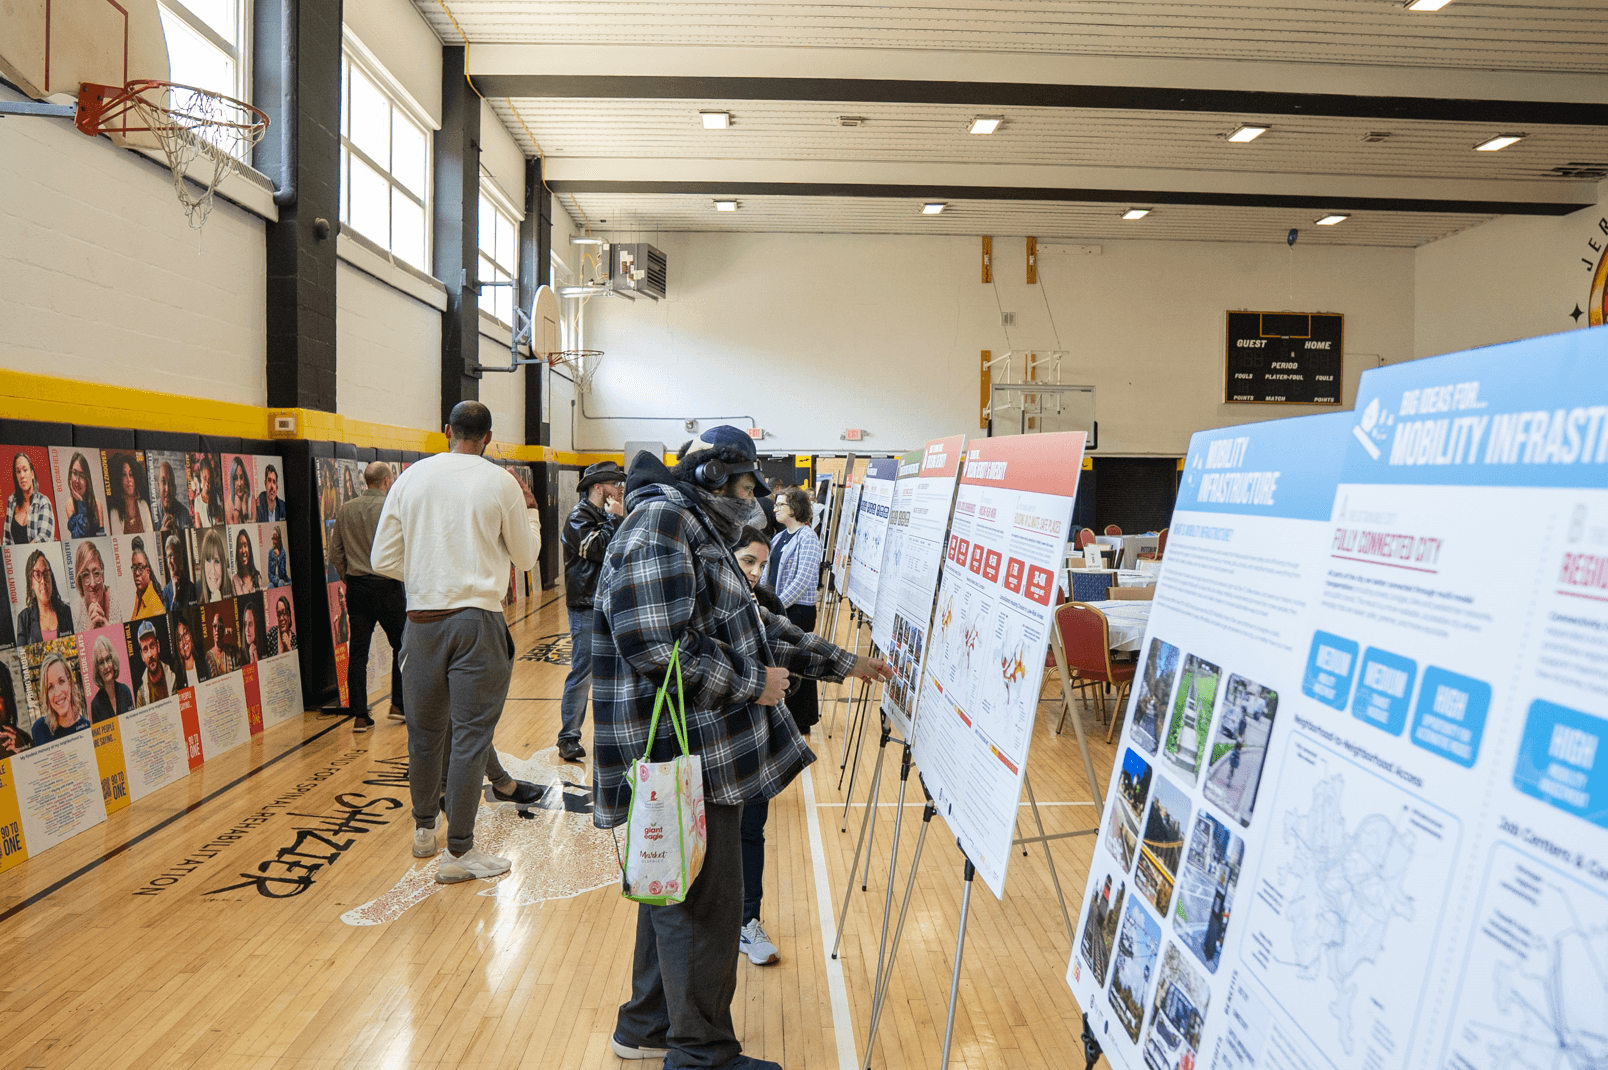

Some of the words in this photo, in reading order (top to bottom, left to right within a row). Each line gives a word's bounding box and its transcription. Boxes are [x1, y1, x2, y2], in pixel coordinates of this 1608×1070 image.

[1236, 339, 1267, 348] GUEST
[1304, 341, 1332, 350] HOME
[1400, 389, 1420, 416] BIG
[1420, 384, 1455, 414] IDEAS
[1205, 436, 1250, 468] MOBILITY
[1389, 416, 1490, 465] MOBILITY
[52, 448, 62, 492] BLOOMFIELD
[101, 450, 112, 496] BELTZHOOVER
[1197, 471, 1281, 505] INFRASTRUCTURE
[64, 542, 73, 564] SOUTH
[113, 538, 122, 577] GREENFIELD
[1332, 528, 1357, 553] FULLY
[1358, 531, 1415, 560] CONNECTED
[1415, 536, 1445, 564] CITY
[4, 548, 14, 576] OLIVER
[66, 567, 75, 589] PERRY
[8, 577, 18, 604] MOUNT
[20, 648, 30, 678] GARDEN
[80, 658, 88, 674] SIDE
[83, 674, 92, 696] SOUTH
[1432, 684, 1469, 722] HIGH
[101, 722, 115, 733] PEOPLE
[60, 737, 80, 748] neighborhood
[188, 736, 193, 745] 90
[193, 734, 198, 743] TO
[190, 743, 200, 758] ONE
[1548, 723, 1600, 770] HIGH
[330, 749, 369, 766] FUND
[1344, 739, 1393, 772] Neighborhood
[1396, 767, 1425, 788] Access
[111, 773, 118, 785] 90
[118, 771, 124, 782] TO
[313, 767, 341, 781] FOR
[113, 784, 126, 800] ONE
[262, 782, 318, 810] SPINAL
[1, 824, 9, 839] 90
[10, 821, 19, 834] TO
[644, 826, 663, 834] giant
[644, 833, 663, 841] eagle
[3, 833, 22, 856] ONE
[132, 811, 276, 896] REHABILITATION
[202, 792, 404, 898] SHAZIER
[640, 850, 666, 859] Market
[1522, 827, 1571, 862] Centers
